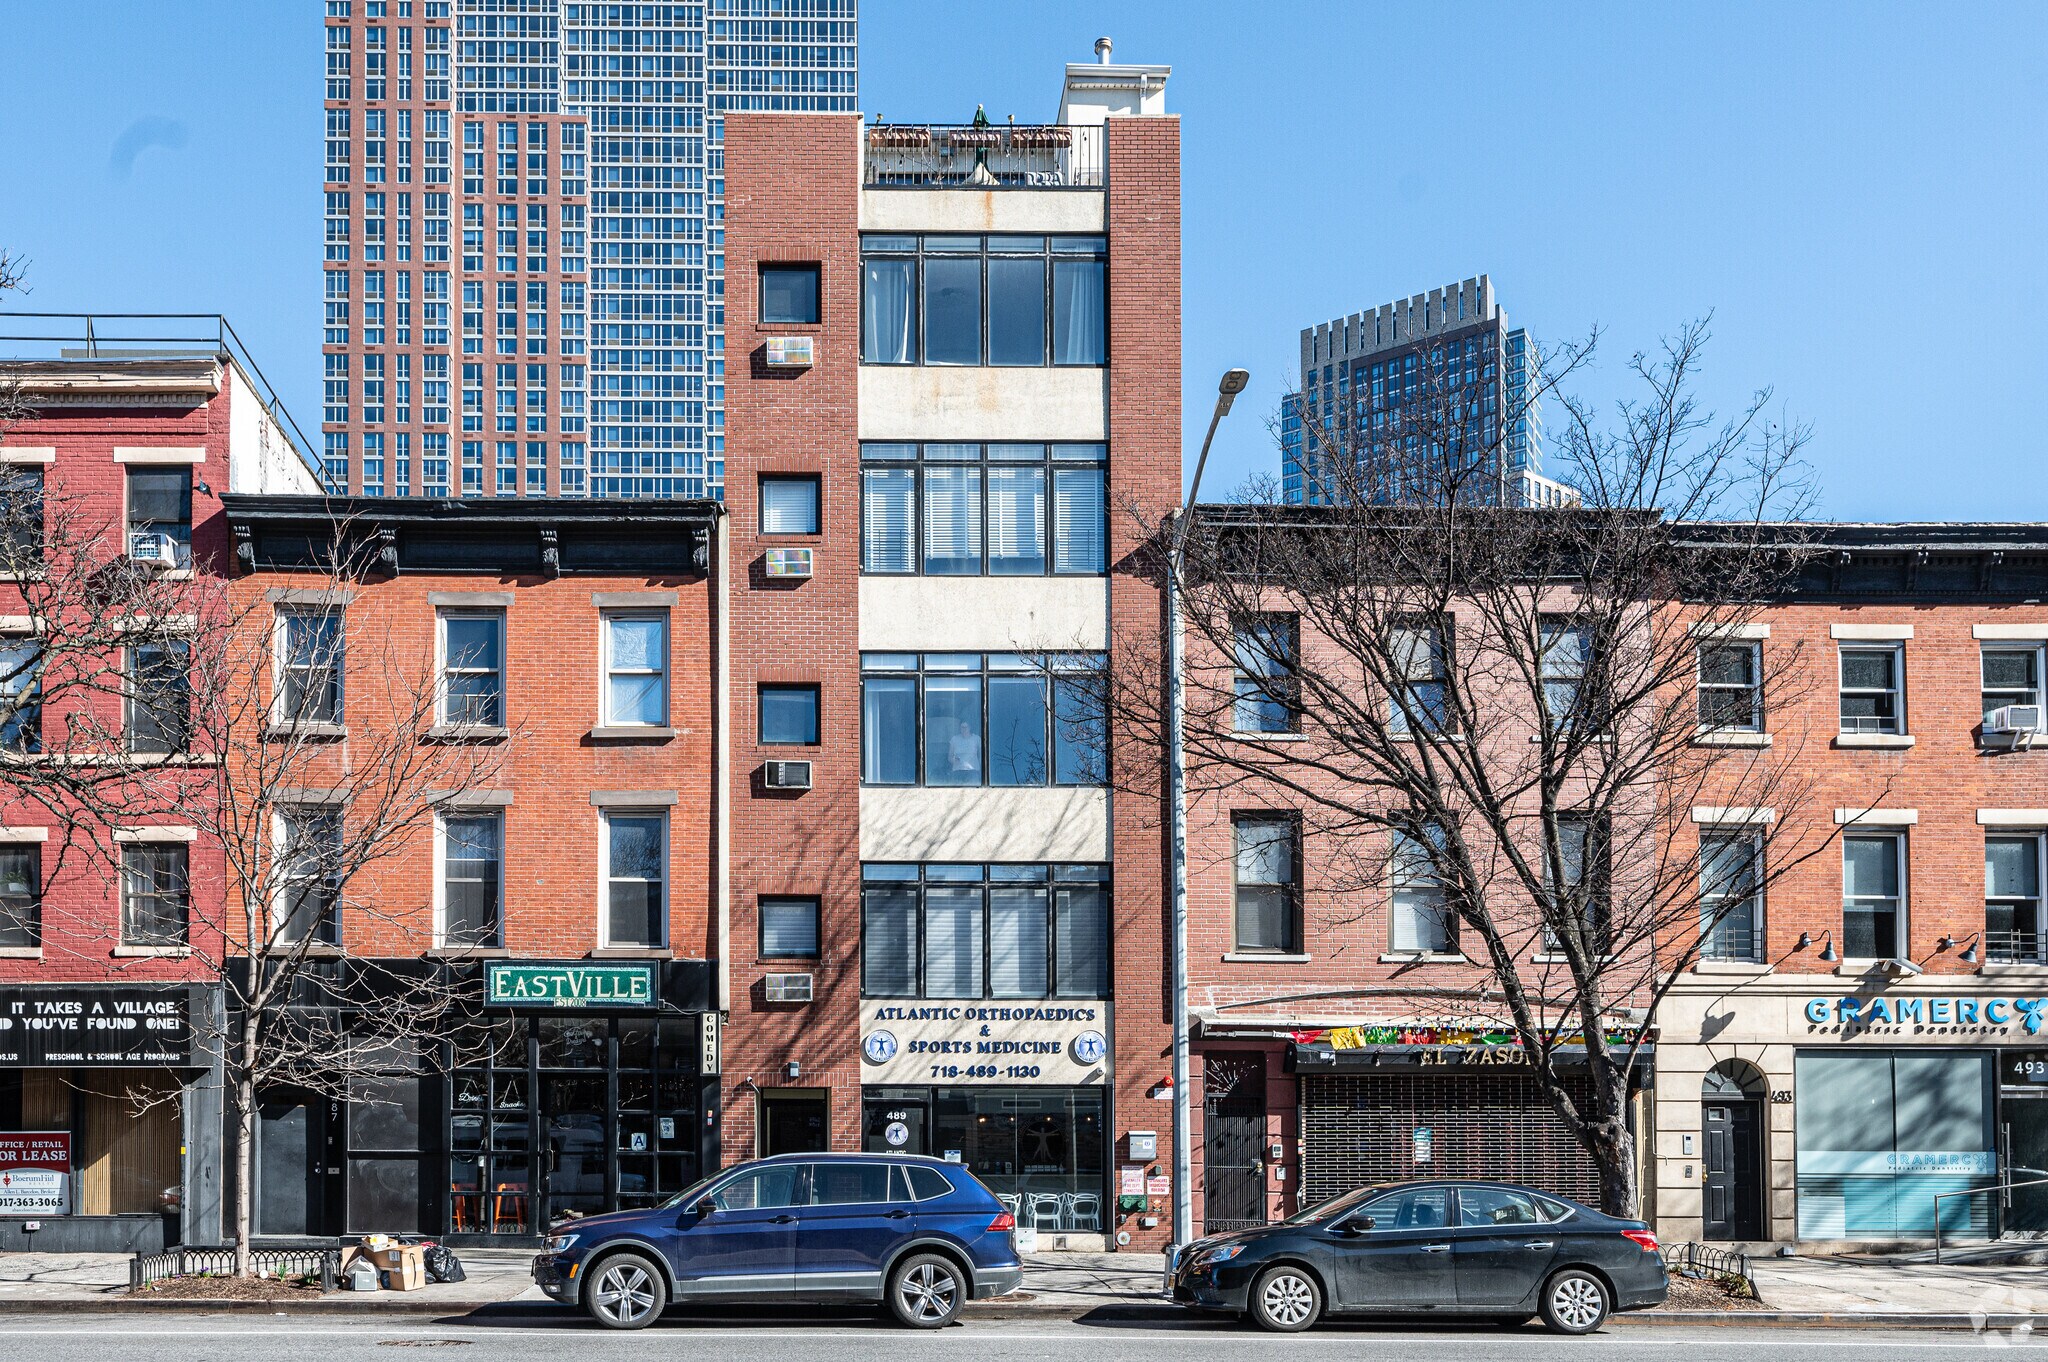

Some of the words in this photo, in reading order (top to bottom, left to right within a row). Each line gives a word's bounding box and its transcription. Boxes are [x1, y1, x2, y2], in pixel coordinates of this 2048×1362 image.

[494, 971, 647, 998] EASTVILLE
[11, 1002, 25, 1014] IT
[35, 1002, 82, 1014] TAKES
[91, 1002, 104, 1014] A
[114, 1002, 179, 1014] VILLAGE.
[874, 1007, 961, 1021] ATLANTIC
[964, 1008, 1096, 1021] ORTHOPAEDICS
[22, 1018, 78, 1030] YOU'VE
[87, 1018, 136, 1030] FOUND
[146, 1018, 180, 1030] ONE!
[1808, 1024, 1901, 1035] Pediatric
[1914, 1024, 2009, 1036] Dentistry
[979, 1024, 991, 1037] &
[706, 1014, 717, 1072] COMEDY
[908, 1041, 972, 1054] SPORTS
[976, 1041, 1062, 1055] MEDICINE
[45, 1053, 84, 1061] PRESCHOOL
[87, 1053, 93, 1061] &
[96, 1053, 123, 1061] SCHOOL
[126, 1053, 141, 1061] AGE
[144, 1053, 180, 1061] PROGRAMS
[1421, 1047, 1447, 1066] EL
[1463, 1046, 1531, 1066] ZASO
[930, 1065, 1041, 1079] 718-489-1130
[2014, 1061, 2045, 1074] 493
[1771, 1090, 1792, 1102] 493
[886, 1111, 907, 1120] 489
[633, 1136, 644, 1146] A
[22, 1151, 68, 1161] LEASE
